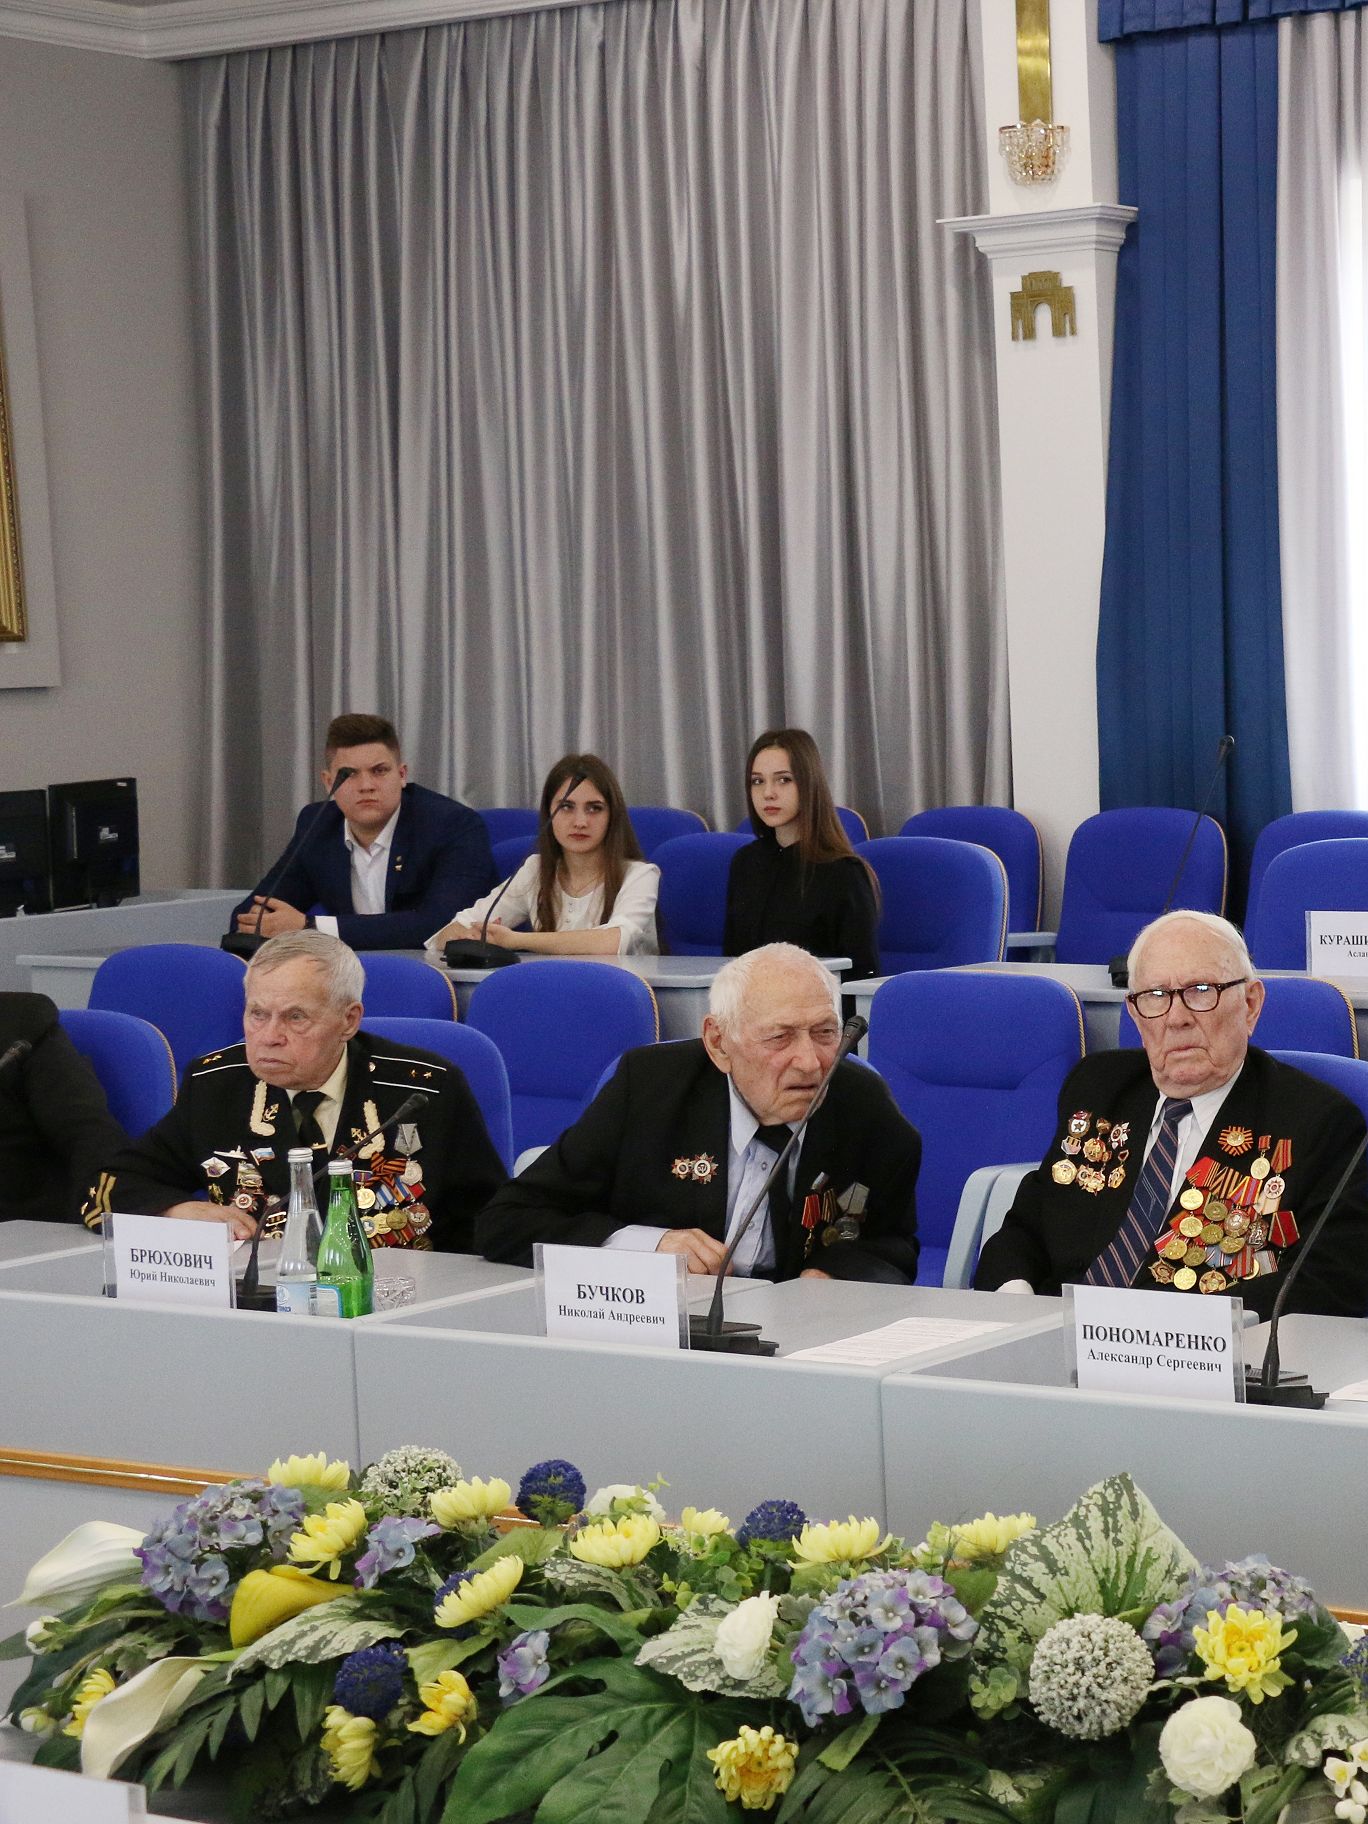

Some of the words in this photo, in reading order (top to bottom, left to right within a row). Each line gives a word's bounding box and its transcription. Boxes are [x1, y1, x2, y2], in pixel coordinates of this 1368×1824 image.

[130, 1247, 214, 1270] БРЮХОВИЧ
[130, 1268, 158, 1282] Юрий
[160, 1271, 216, 1287] Николаевич
[576, 1283, 646, 1305] БУЧКОВ
[558, 1304, 605, 1320] Николай
[608, 1309, 666, 1325] Андреевич
[1082, 1324, 1227, 1353] ПОНОМАРЕНКО
[1087, 1348, 1153, 1369] Александр
[1156, 1353, 1222, 1373] Сергеевич
